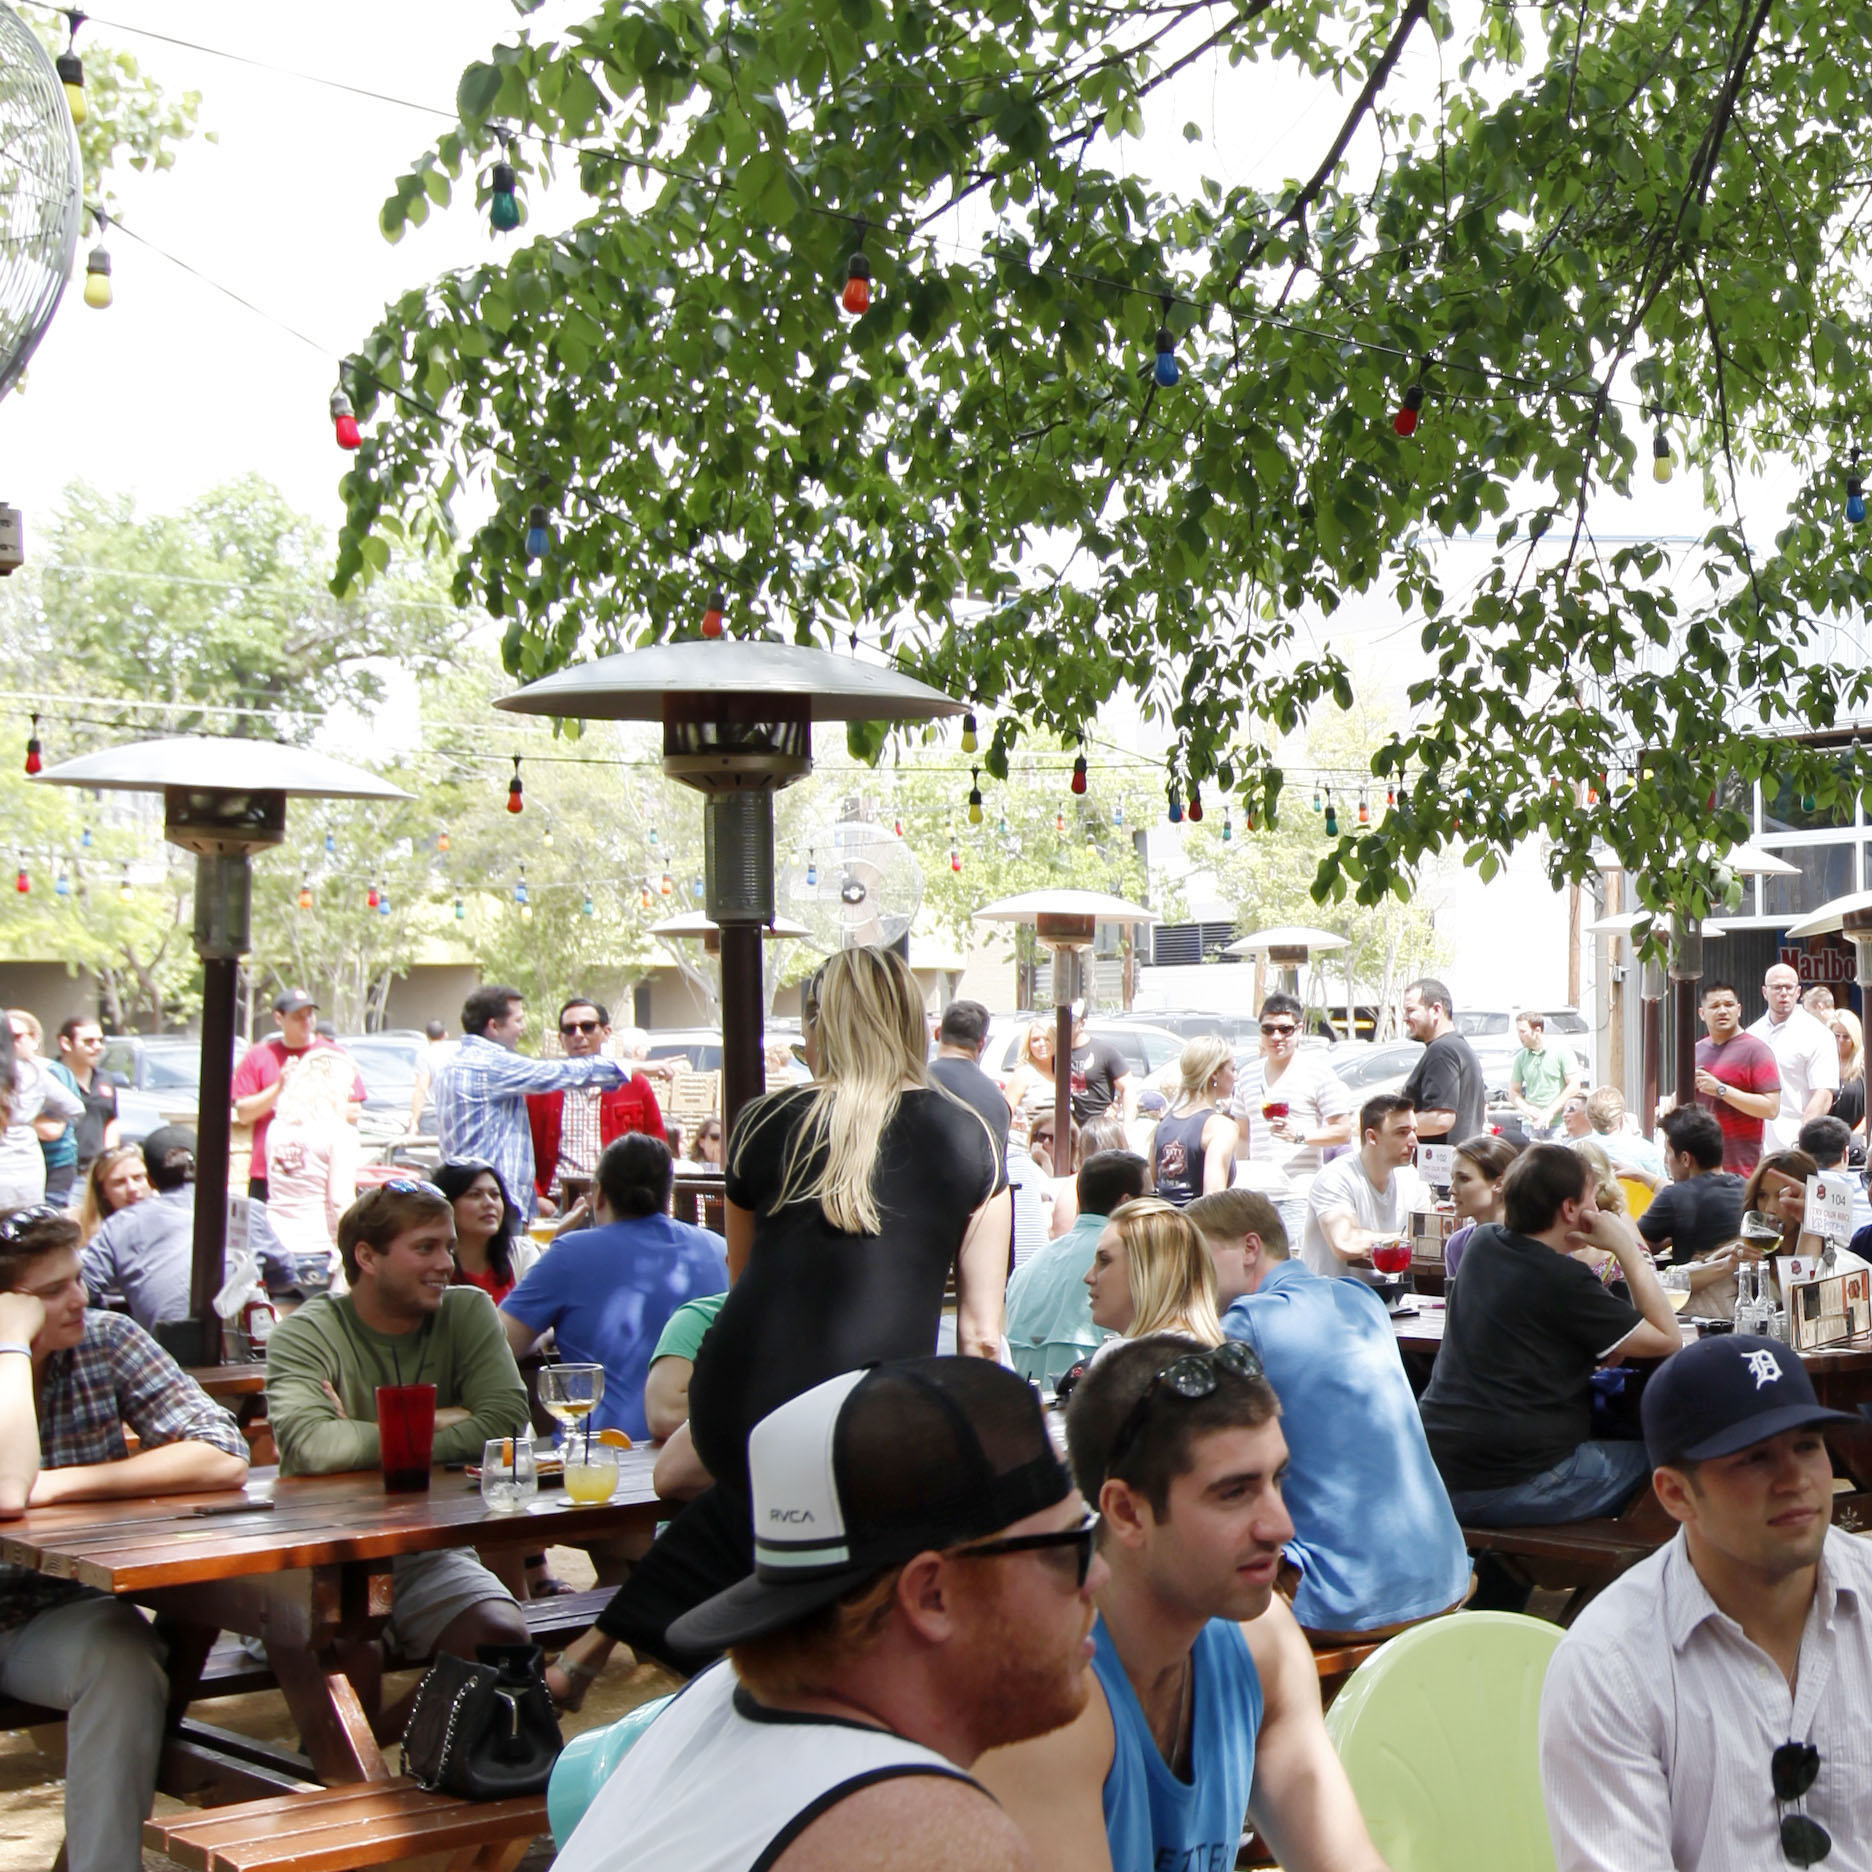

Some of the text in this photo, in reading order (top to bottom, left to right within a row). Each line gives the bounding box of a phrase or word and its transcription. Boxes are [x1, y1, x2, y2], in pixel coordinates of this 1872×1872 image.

[1832, 1193, 1846, 1205] 104
[1741, 1349, 1783, 1389] D
[770, 1508, 816, 1524] RVCA
